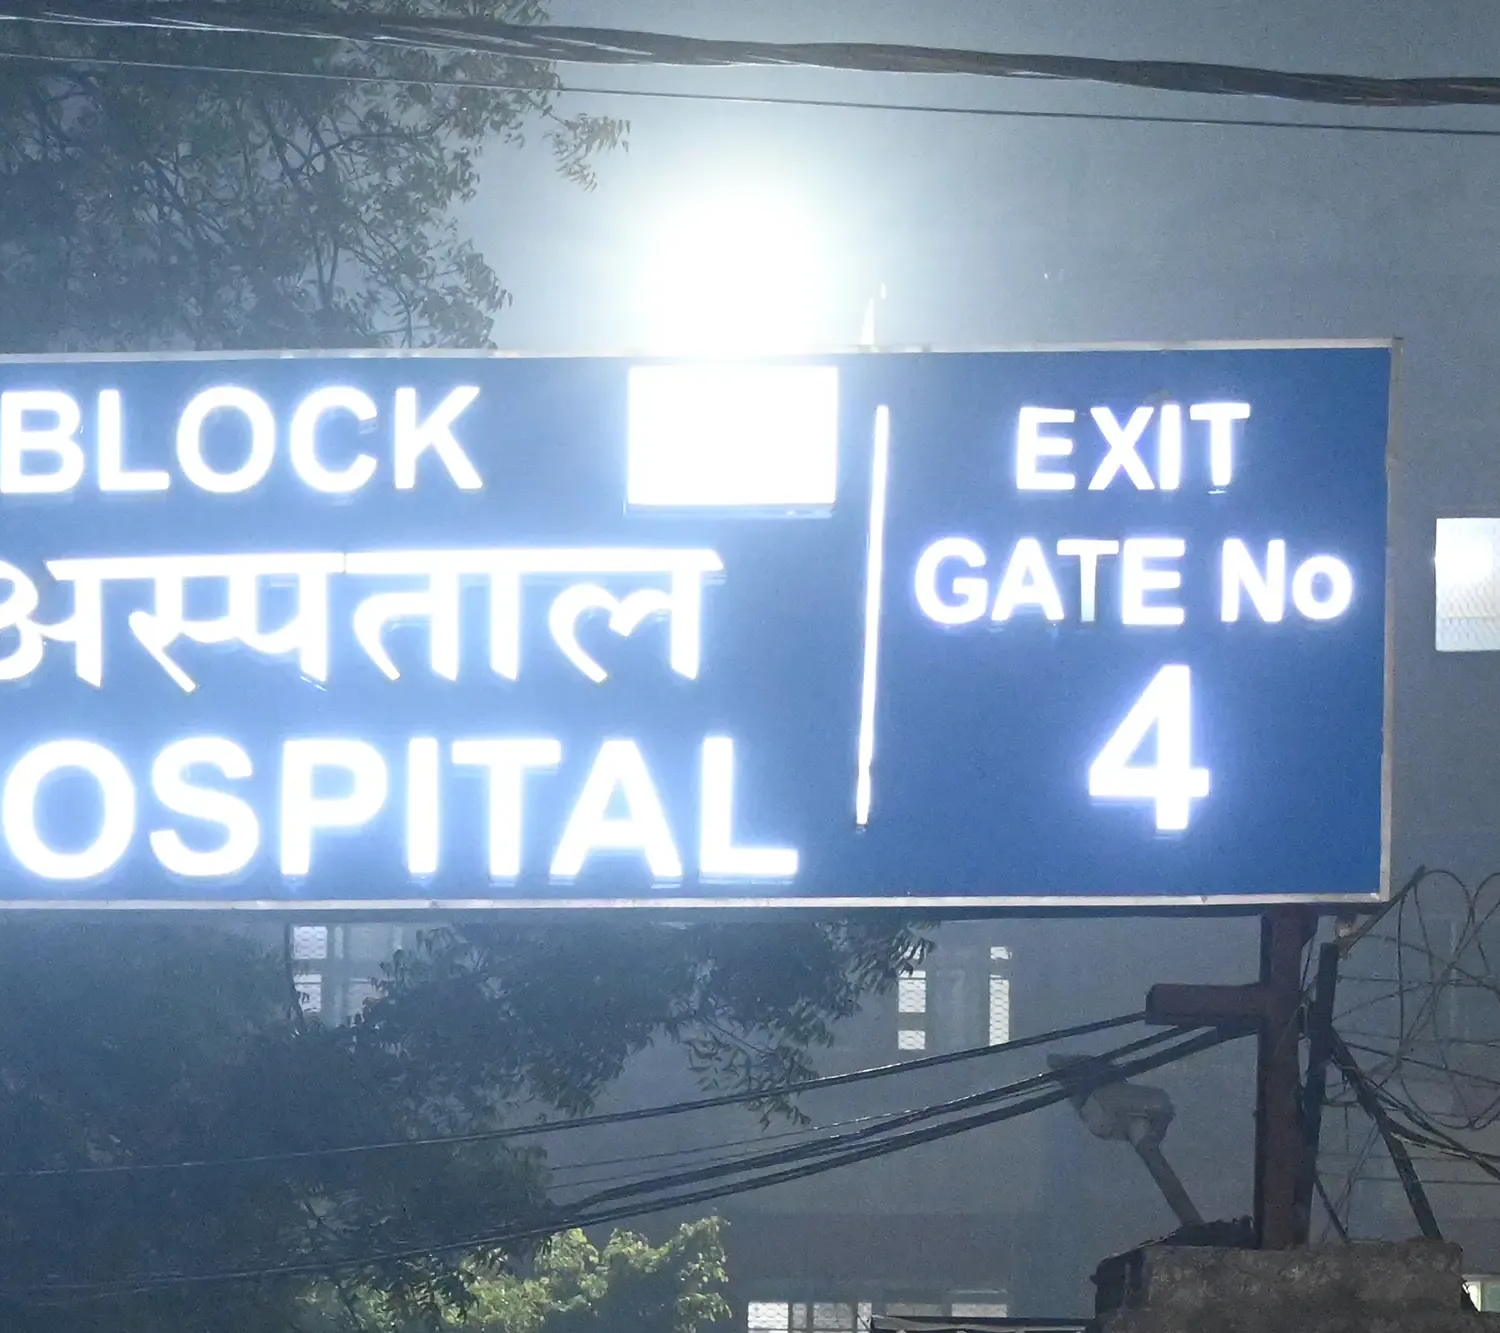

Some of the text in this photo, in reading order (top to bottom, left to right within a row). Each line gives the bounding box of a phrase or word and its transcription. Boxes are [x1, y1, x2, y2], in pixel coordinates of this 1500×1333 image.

[0, 384, 483, 494] BLOCK
[1015, 400, 1251, 494] EXIT
[913, 534, 1355, 629] GATE No
[1085, 660, 1212, 836] 4
